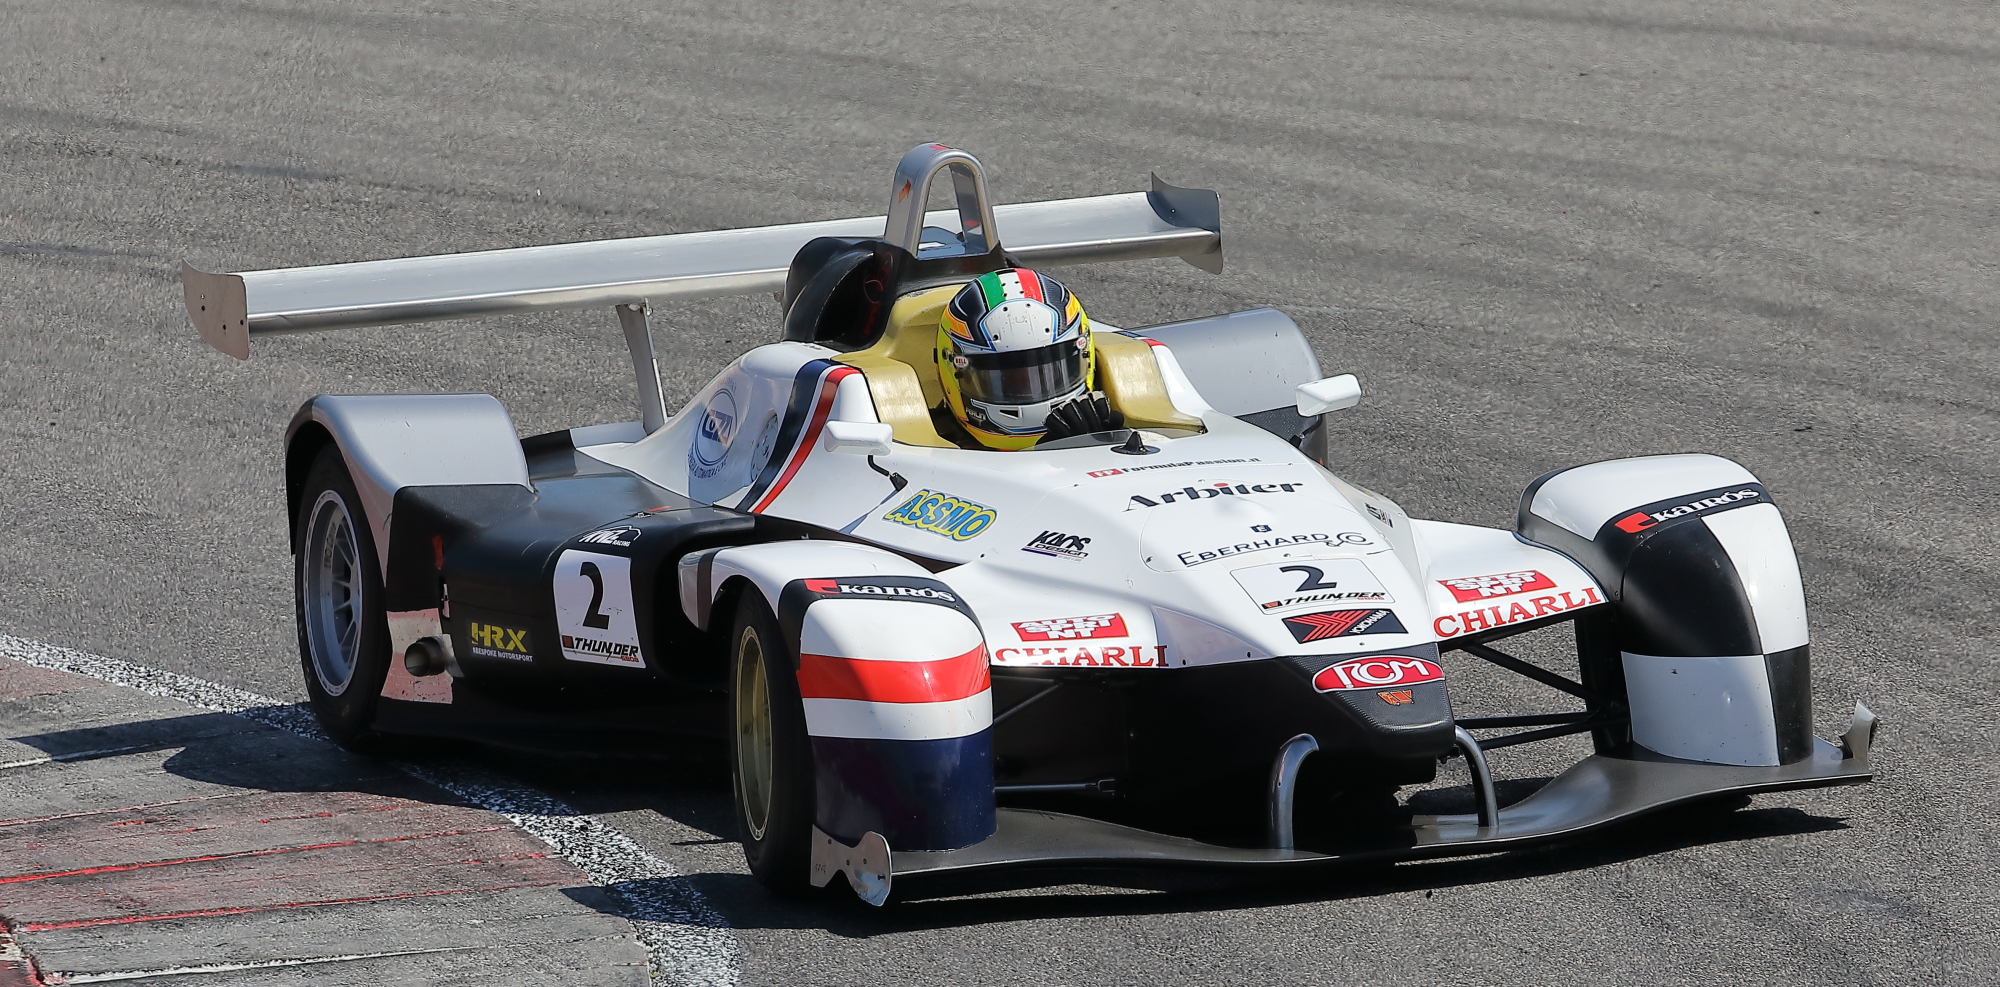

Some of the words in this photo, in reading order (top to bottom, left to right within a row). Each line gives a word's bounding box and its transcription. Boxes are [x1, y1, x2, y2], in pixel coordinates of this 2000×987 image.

[1122, 482, 1304, 512] Arbiter
[883, 489, 998, 541] ASSMO
[1027, 530, 1091, 551] KAOS
[1035, 544, 1089, 557] DESIGN
[1177, 533, 1330, 566] EBERHARD
[1279, 565, 1338, 593] 2
[1446, 571, 1537, 585] AUTO
[580, 561, 610, 630] 2
[1285, 592, 1386, 605] THUNDER
[1478, 583, 1523, 597] NT
[1018, 615, 1117, 629] AUTO
[1350, 609, 1391, 634] YOKOHAMA
[1433, 587, 1602, 638] CHIARLI
[472, 622, 527, 653] HRX
[1047, 628, 1096, 640] NT
[472, 647, 497, 657] BESPOKE
[498, 651, 533, 662] MOTORSPORT
[575, 637, 639, 659] THUNDER
